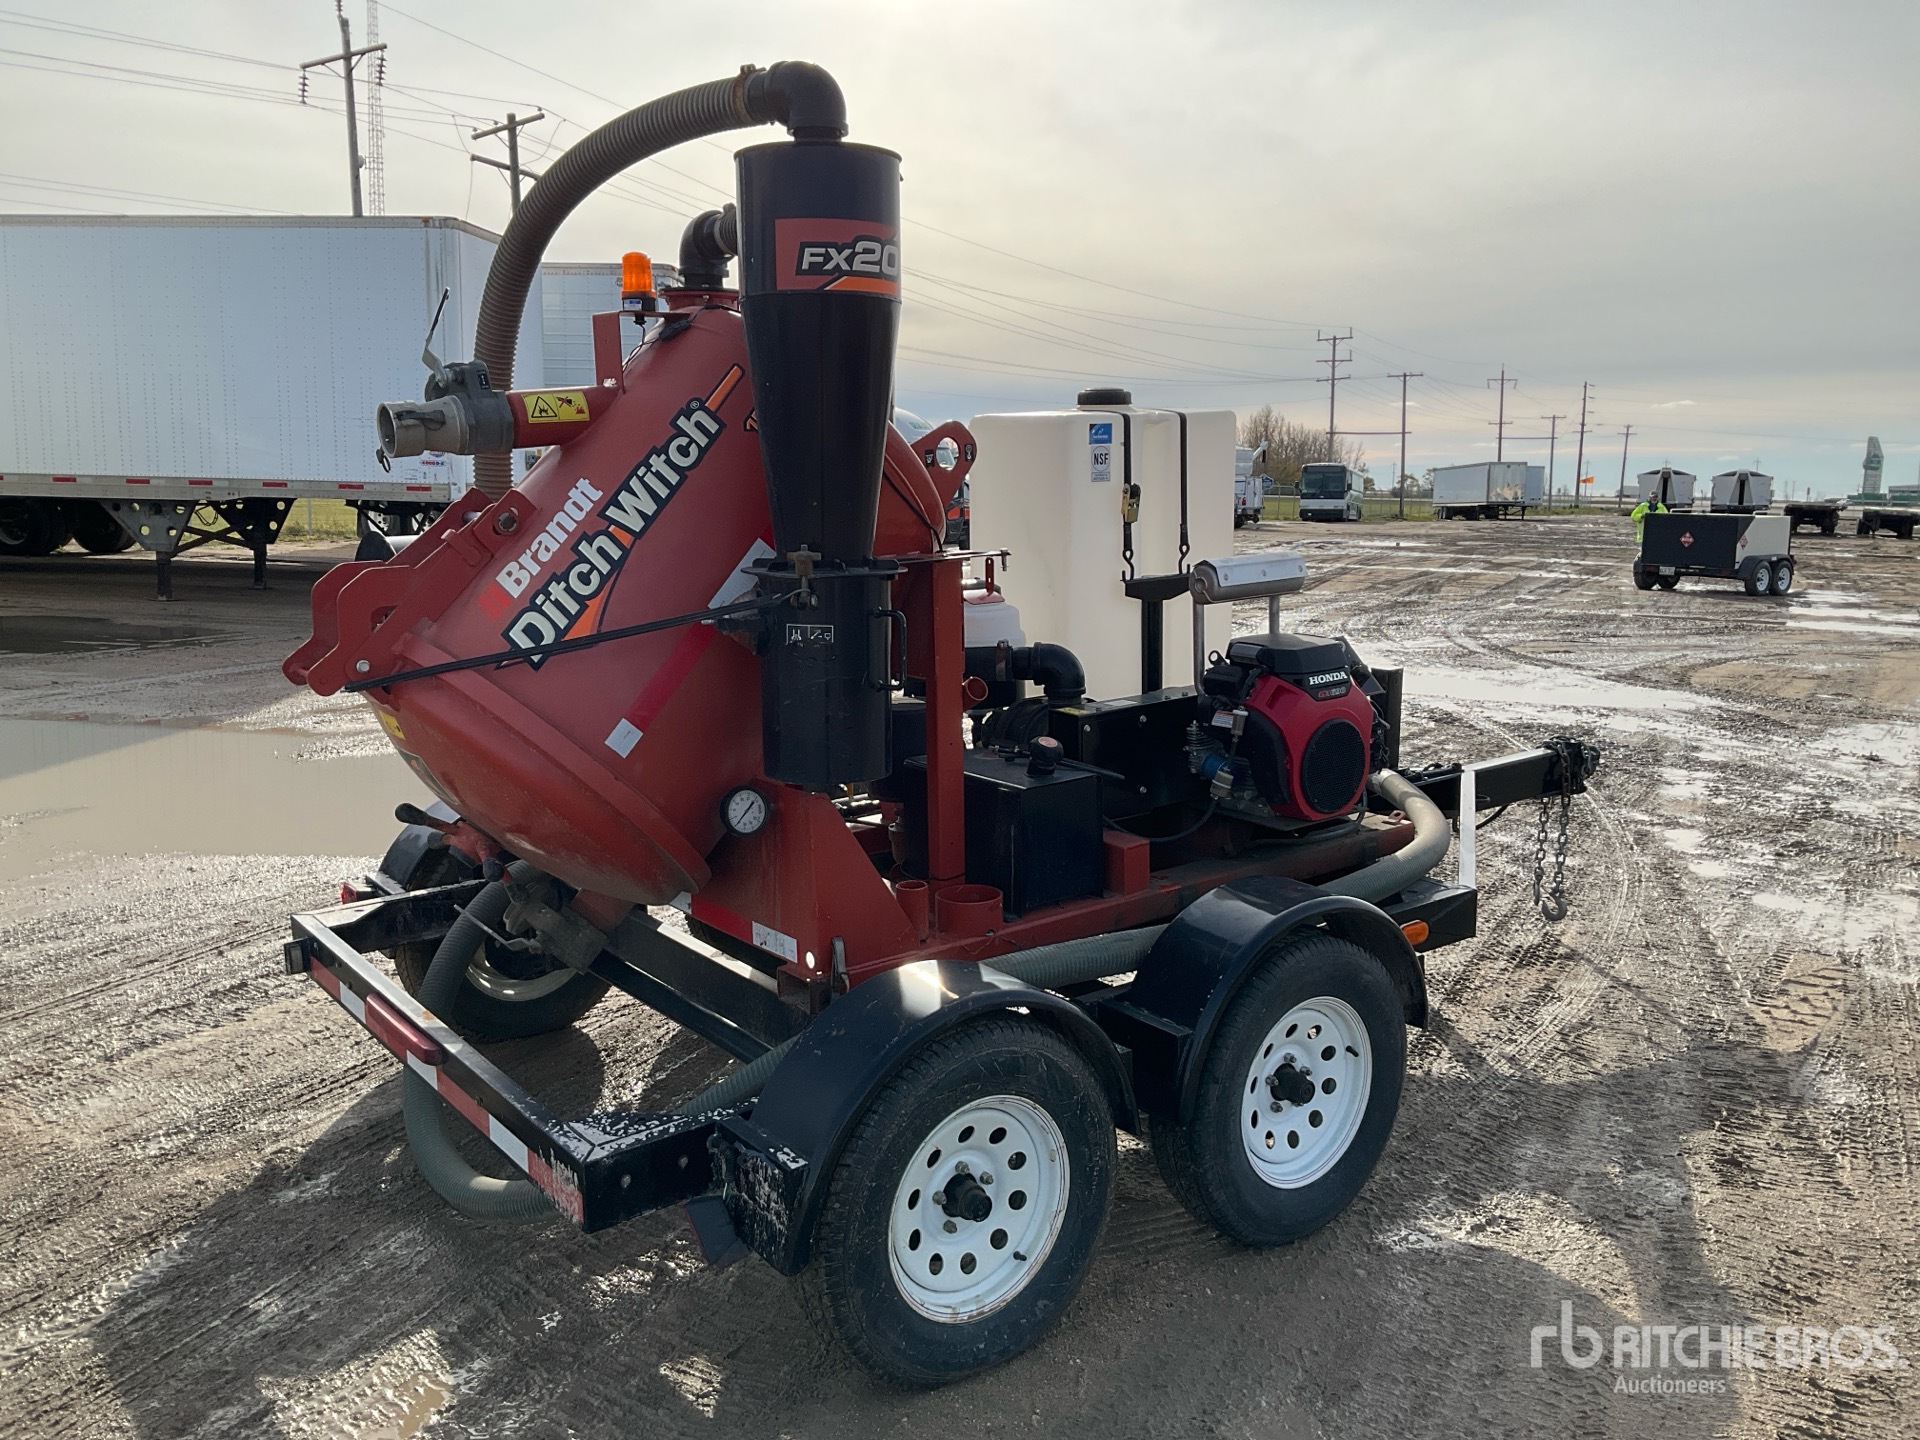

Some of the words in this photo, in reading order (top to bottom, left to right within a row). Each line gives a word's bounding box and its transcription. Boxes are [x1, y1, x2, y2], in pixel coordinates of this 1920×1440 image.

[801, 240, 899, 277] FX20
[1093, 452, 1109, 466] NSF
[495, 477, 604, 599] Brandt
[508, 533, 623, 663] Ditch
[605, 408, 720, 533] Witch
[1309, 671, 1348, 685] HONDA
